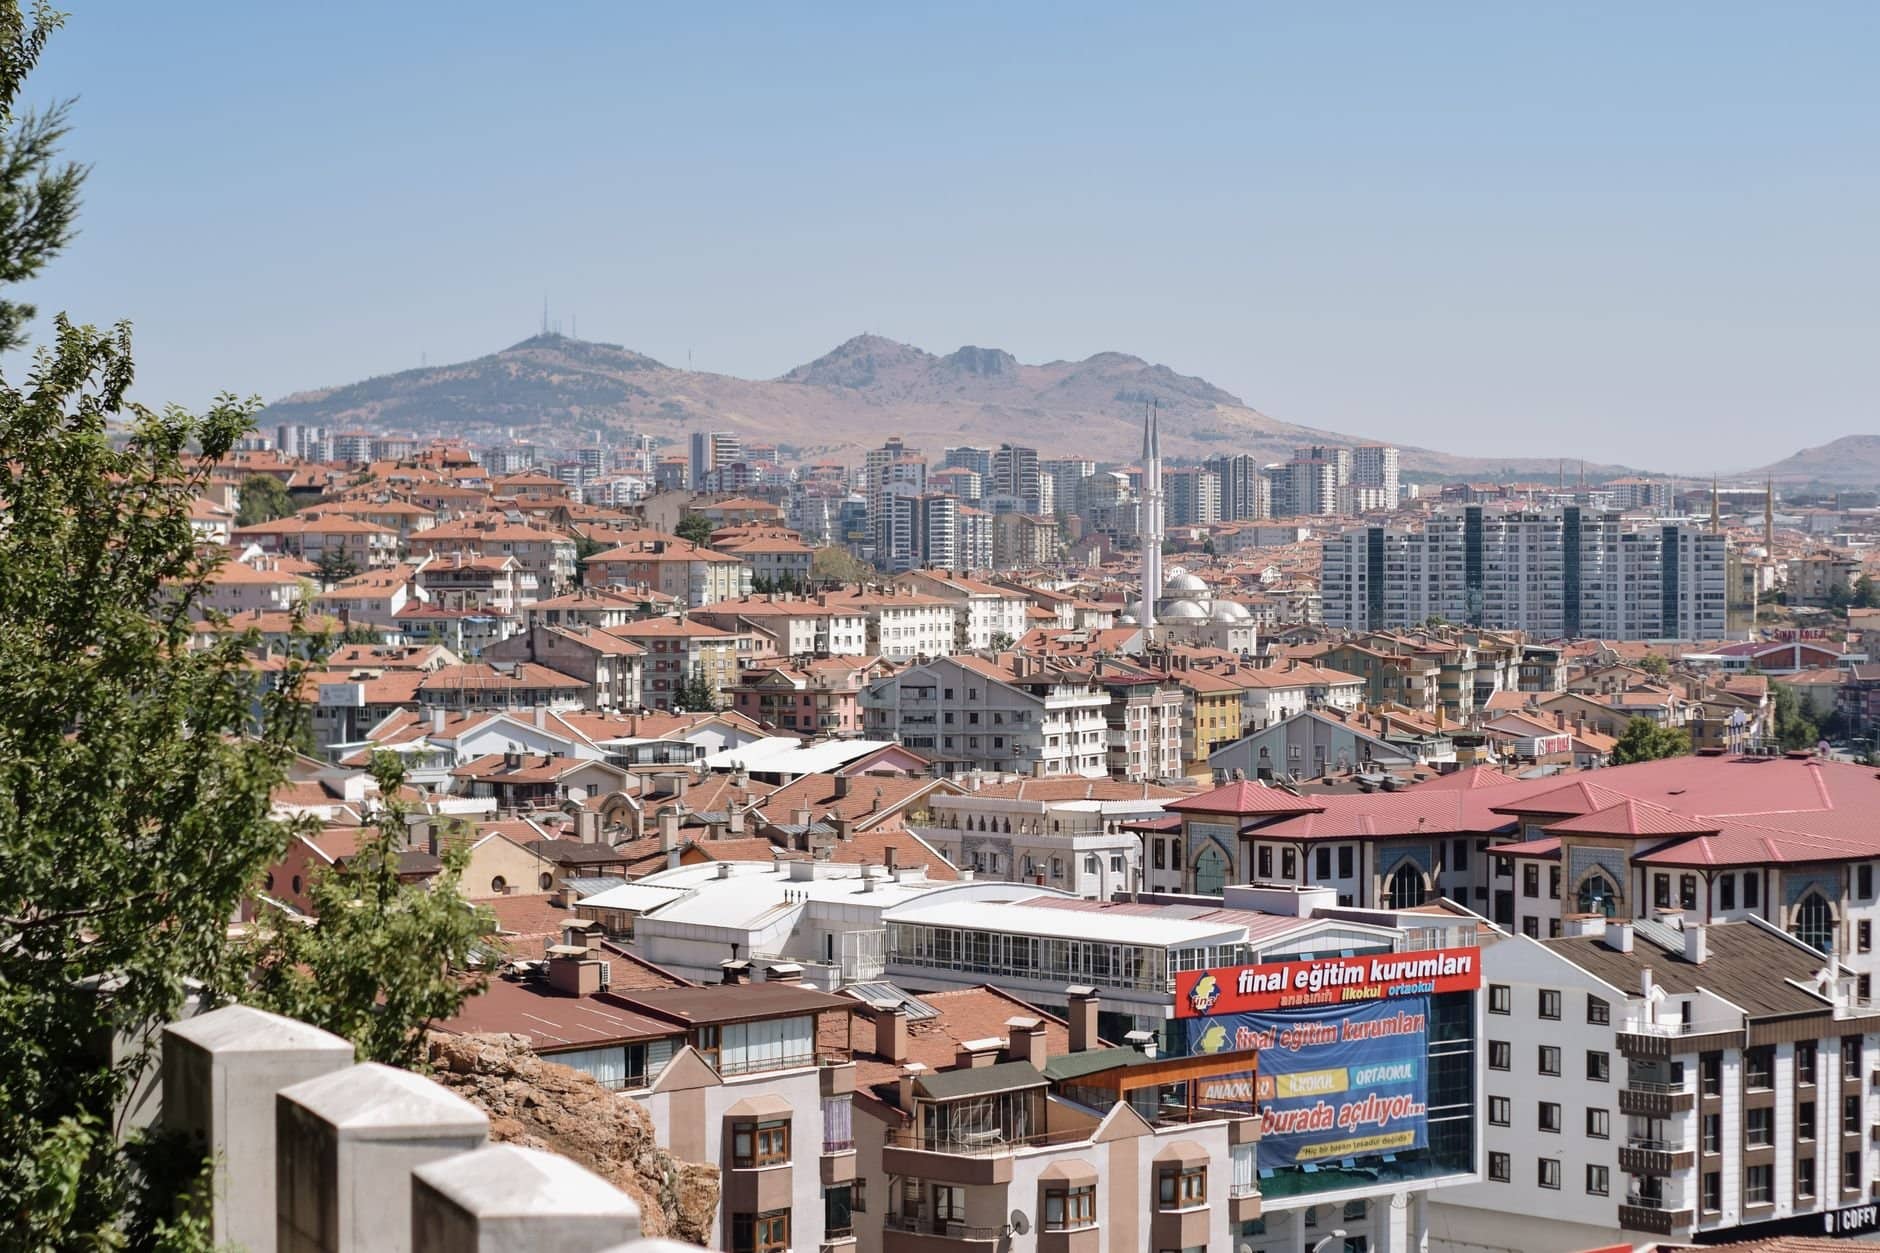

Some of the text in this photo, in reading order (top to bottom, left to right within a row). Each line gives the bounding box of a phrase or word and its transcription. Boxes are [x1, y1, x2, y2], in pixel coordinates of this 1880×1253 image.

[1238, 953, 1471, 993] final eğitim kurumları
[1388, 980, 1435, 996] ortaokul
[1235, 1011, 1425, 1051] final eğitim kurumları
[1289, 1073, 1335, 1092] İLKOKUL
[1355, 1063, 1412, 1085] ORTAOKUL
[1206, 1080, 1270, 1098] ANAOKUU
[1261, 1093, 1425, 1135] burada açılıyor...
[1843, 1206, 1877, 1230] COFFY
